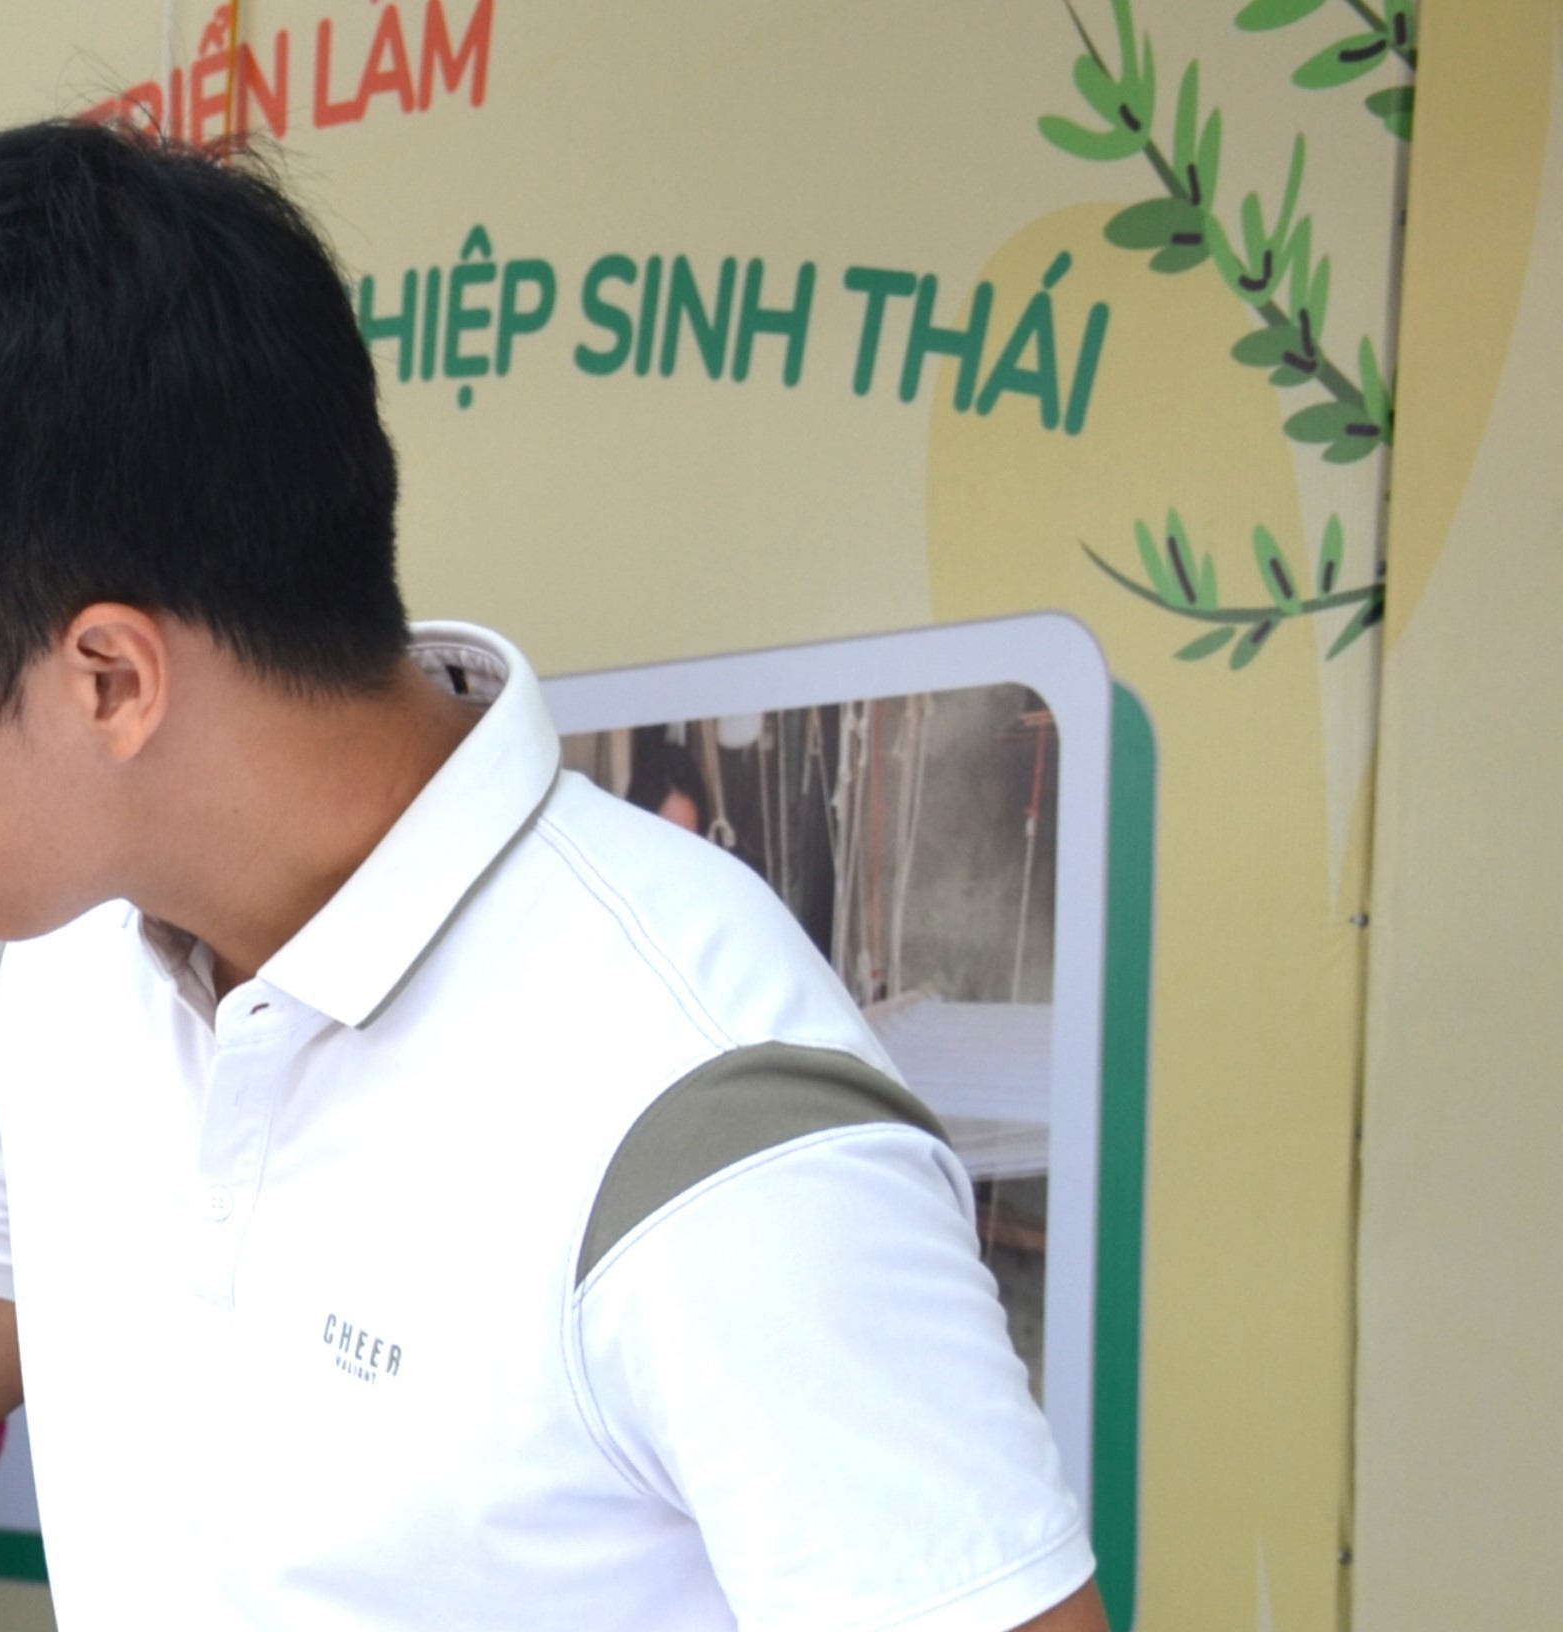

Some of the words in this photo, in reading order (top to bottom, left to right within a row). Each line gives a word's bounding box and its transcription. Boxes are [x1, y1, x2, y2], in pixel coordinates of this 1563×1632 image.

[358, 225, 557, 410] HIỆP
[574, 253, 816, 388] SINH
[843, 250, 1110, 437] THÁI
[323, 1313, 402, 1377] CHEER
